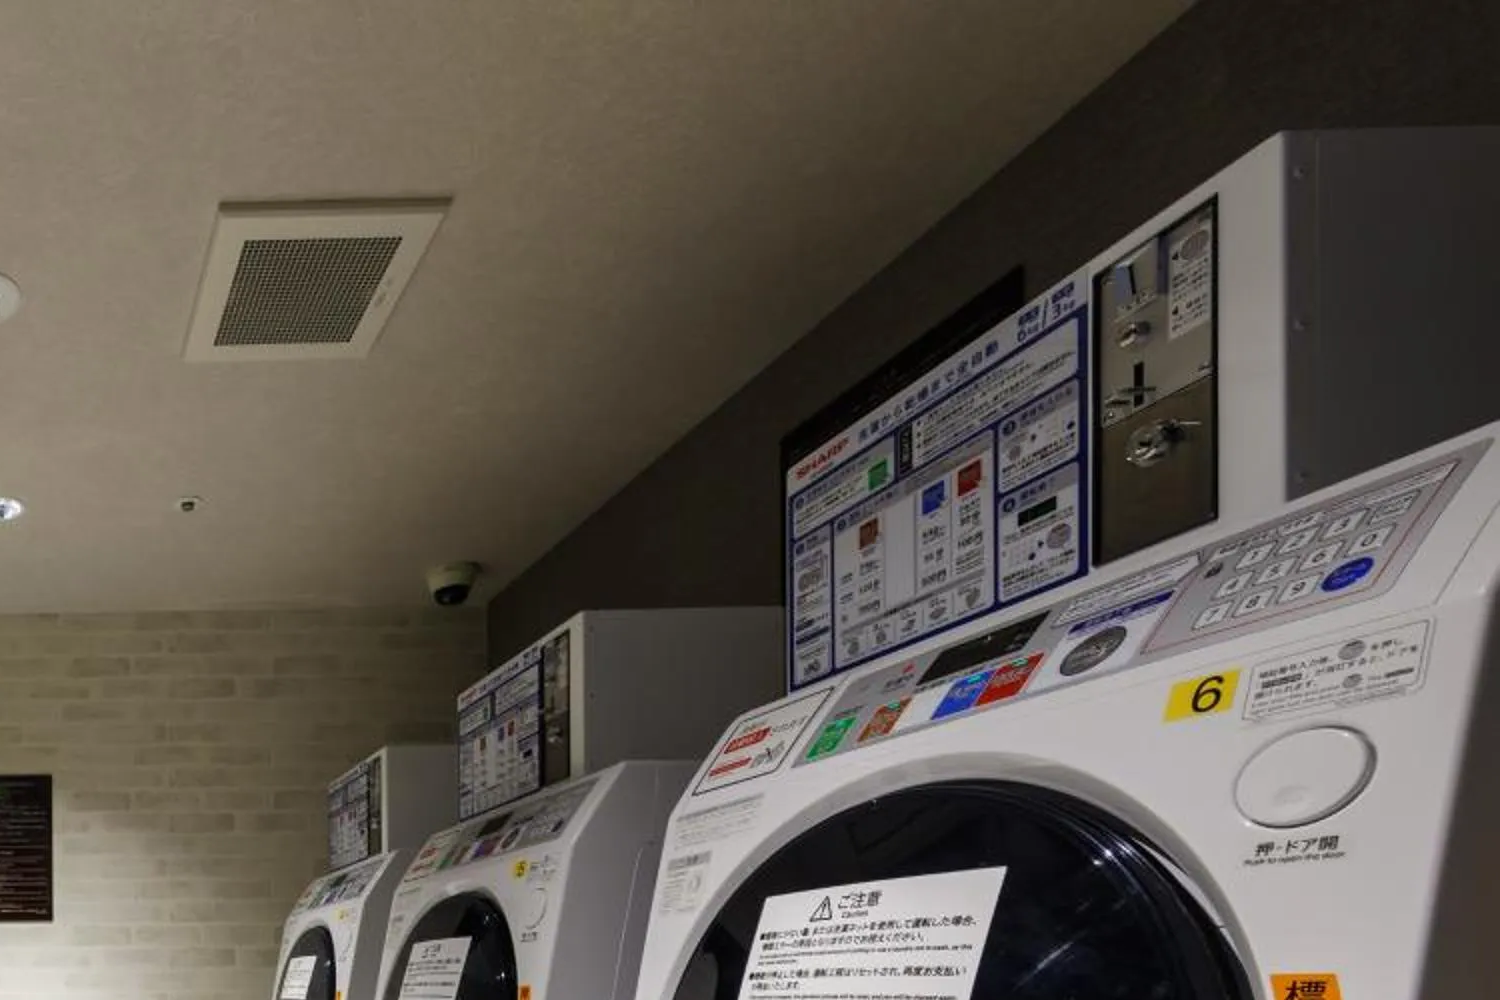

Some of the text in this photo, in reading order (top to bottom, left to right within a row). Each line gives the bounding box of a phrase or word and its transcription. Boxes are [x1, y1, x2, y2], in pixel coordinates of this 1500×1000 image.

[1190, 675, 1224, 713] 6
[837, 890, 882, 910] ご注意
